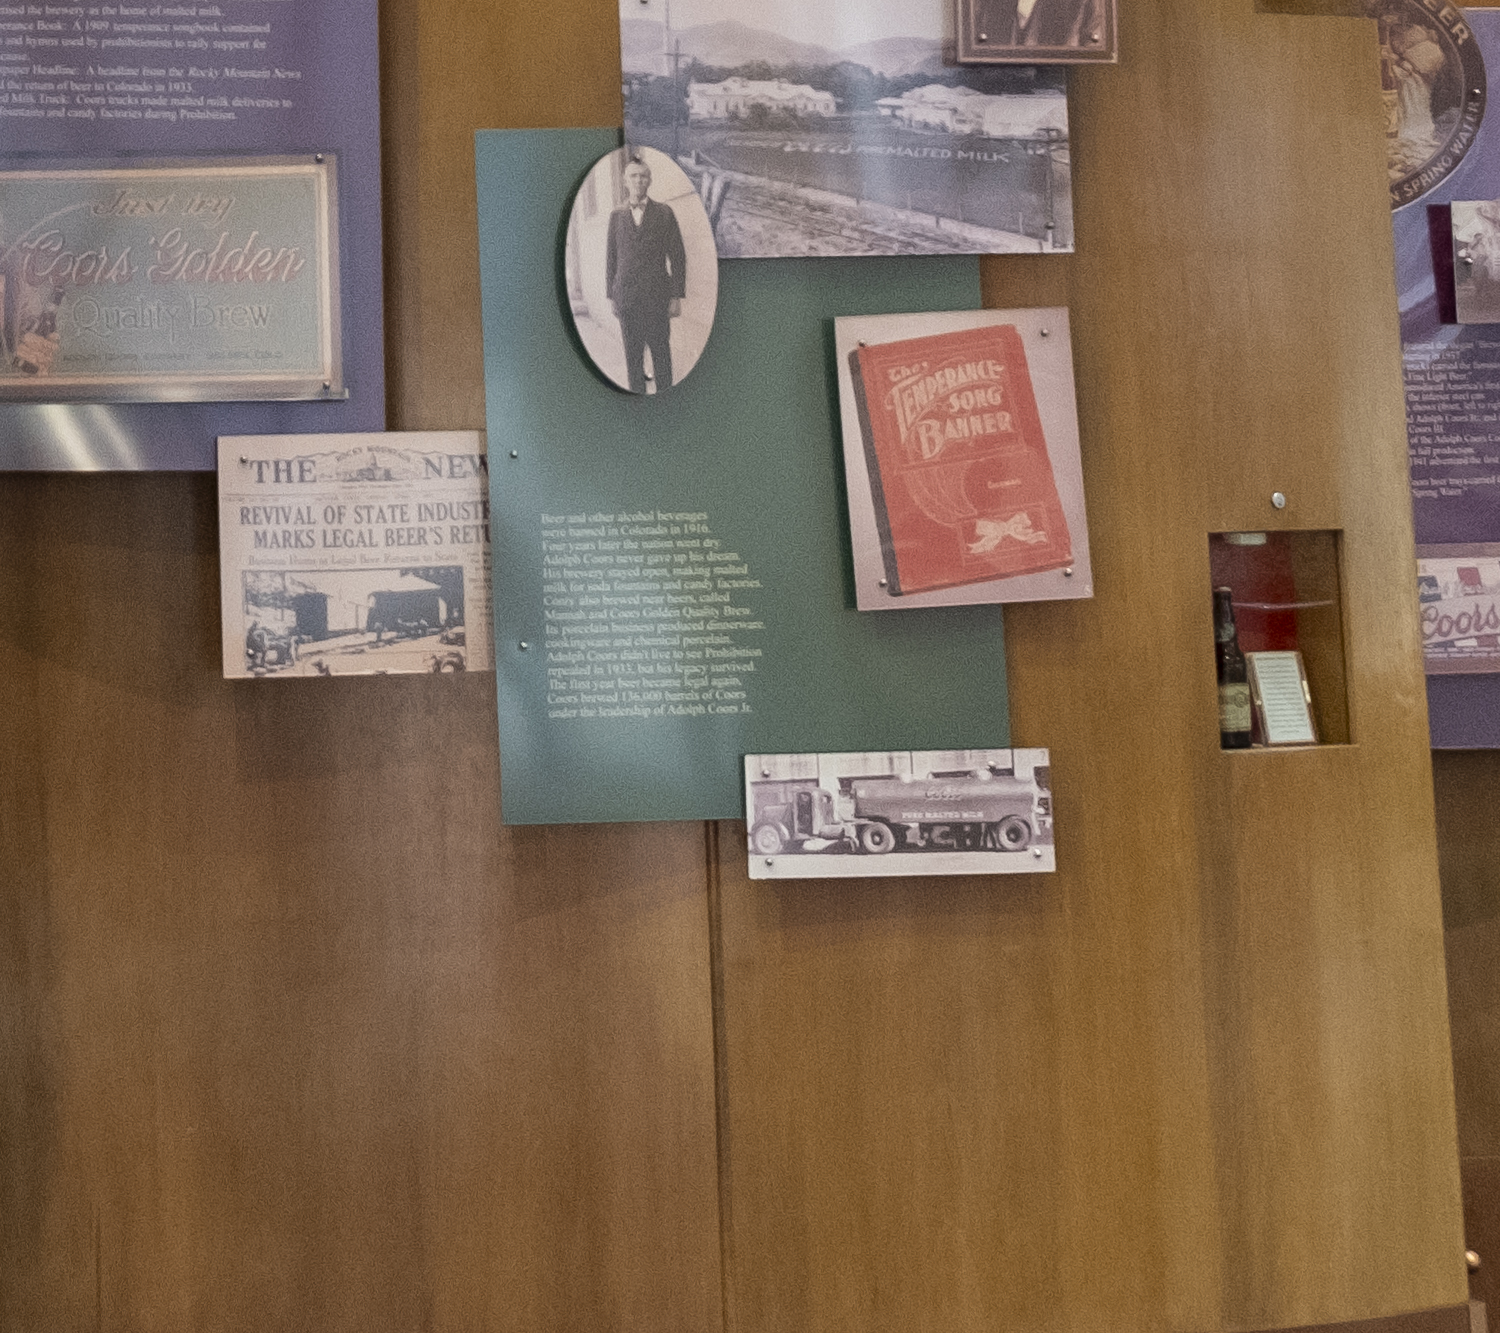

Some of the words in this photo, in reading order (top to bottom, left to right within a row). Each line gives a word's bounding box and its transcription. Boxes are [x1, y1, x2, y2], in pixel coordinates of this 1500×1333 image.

[1404, 157, 1452, 196] SPRING
[22, 229, 133, 286] Coors
[148, 228, 305, 284] Golden
[73, 296, 179, 343] Quality
[193, 295, 271, 328] Brew
[884, 359, 1004, 445] TEMPERANCE
[949, 385, 1003, 411] SONG
[918, 411, 1012, 460] BANNER
[251, 460, 317, 483] THE
[240, 505, 315, 525] REVIVAL
[324, 505, 347, 524] OF
[354, 504, 409, 523] STATE
[254, 529, 315, 548] MARKS
[323, 528, 377, 548] LEGAL
[385, 526, 443, 547] BEER'S
[1421, 603, 1500, 639] Coors
